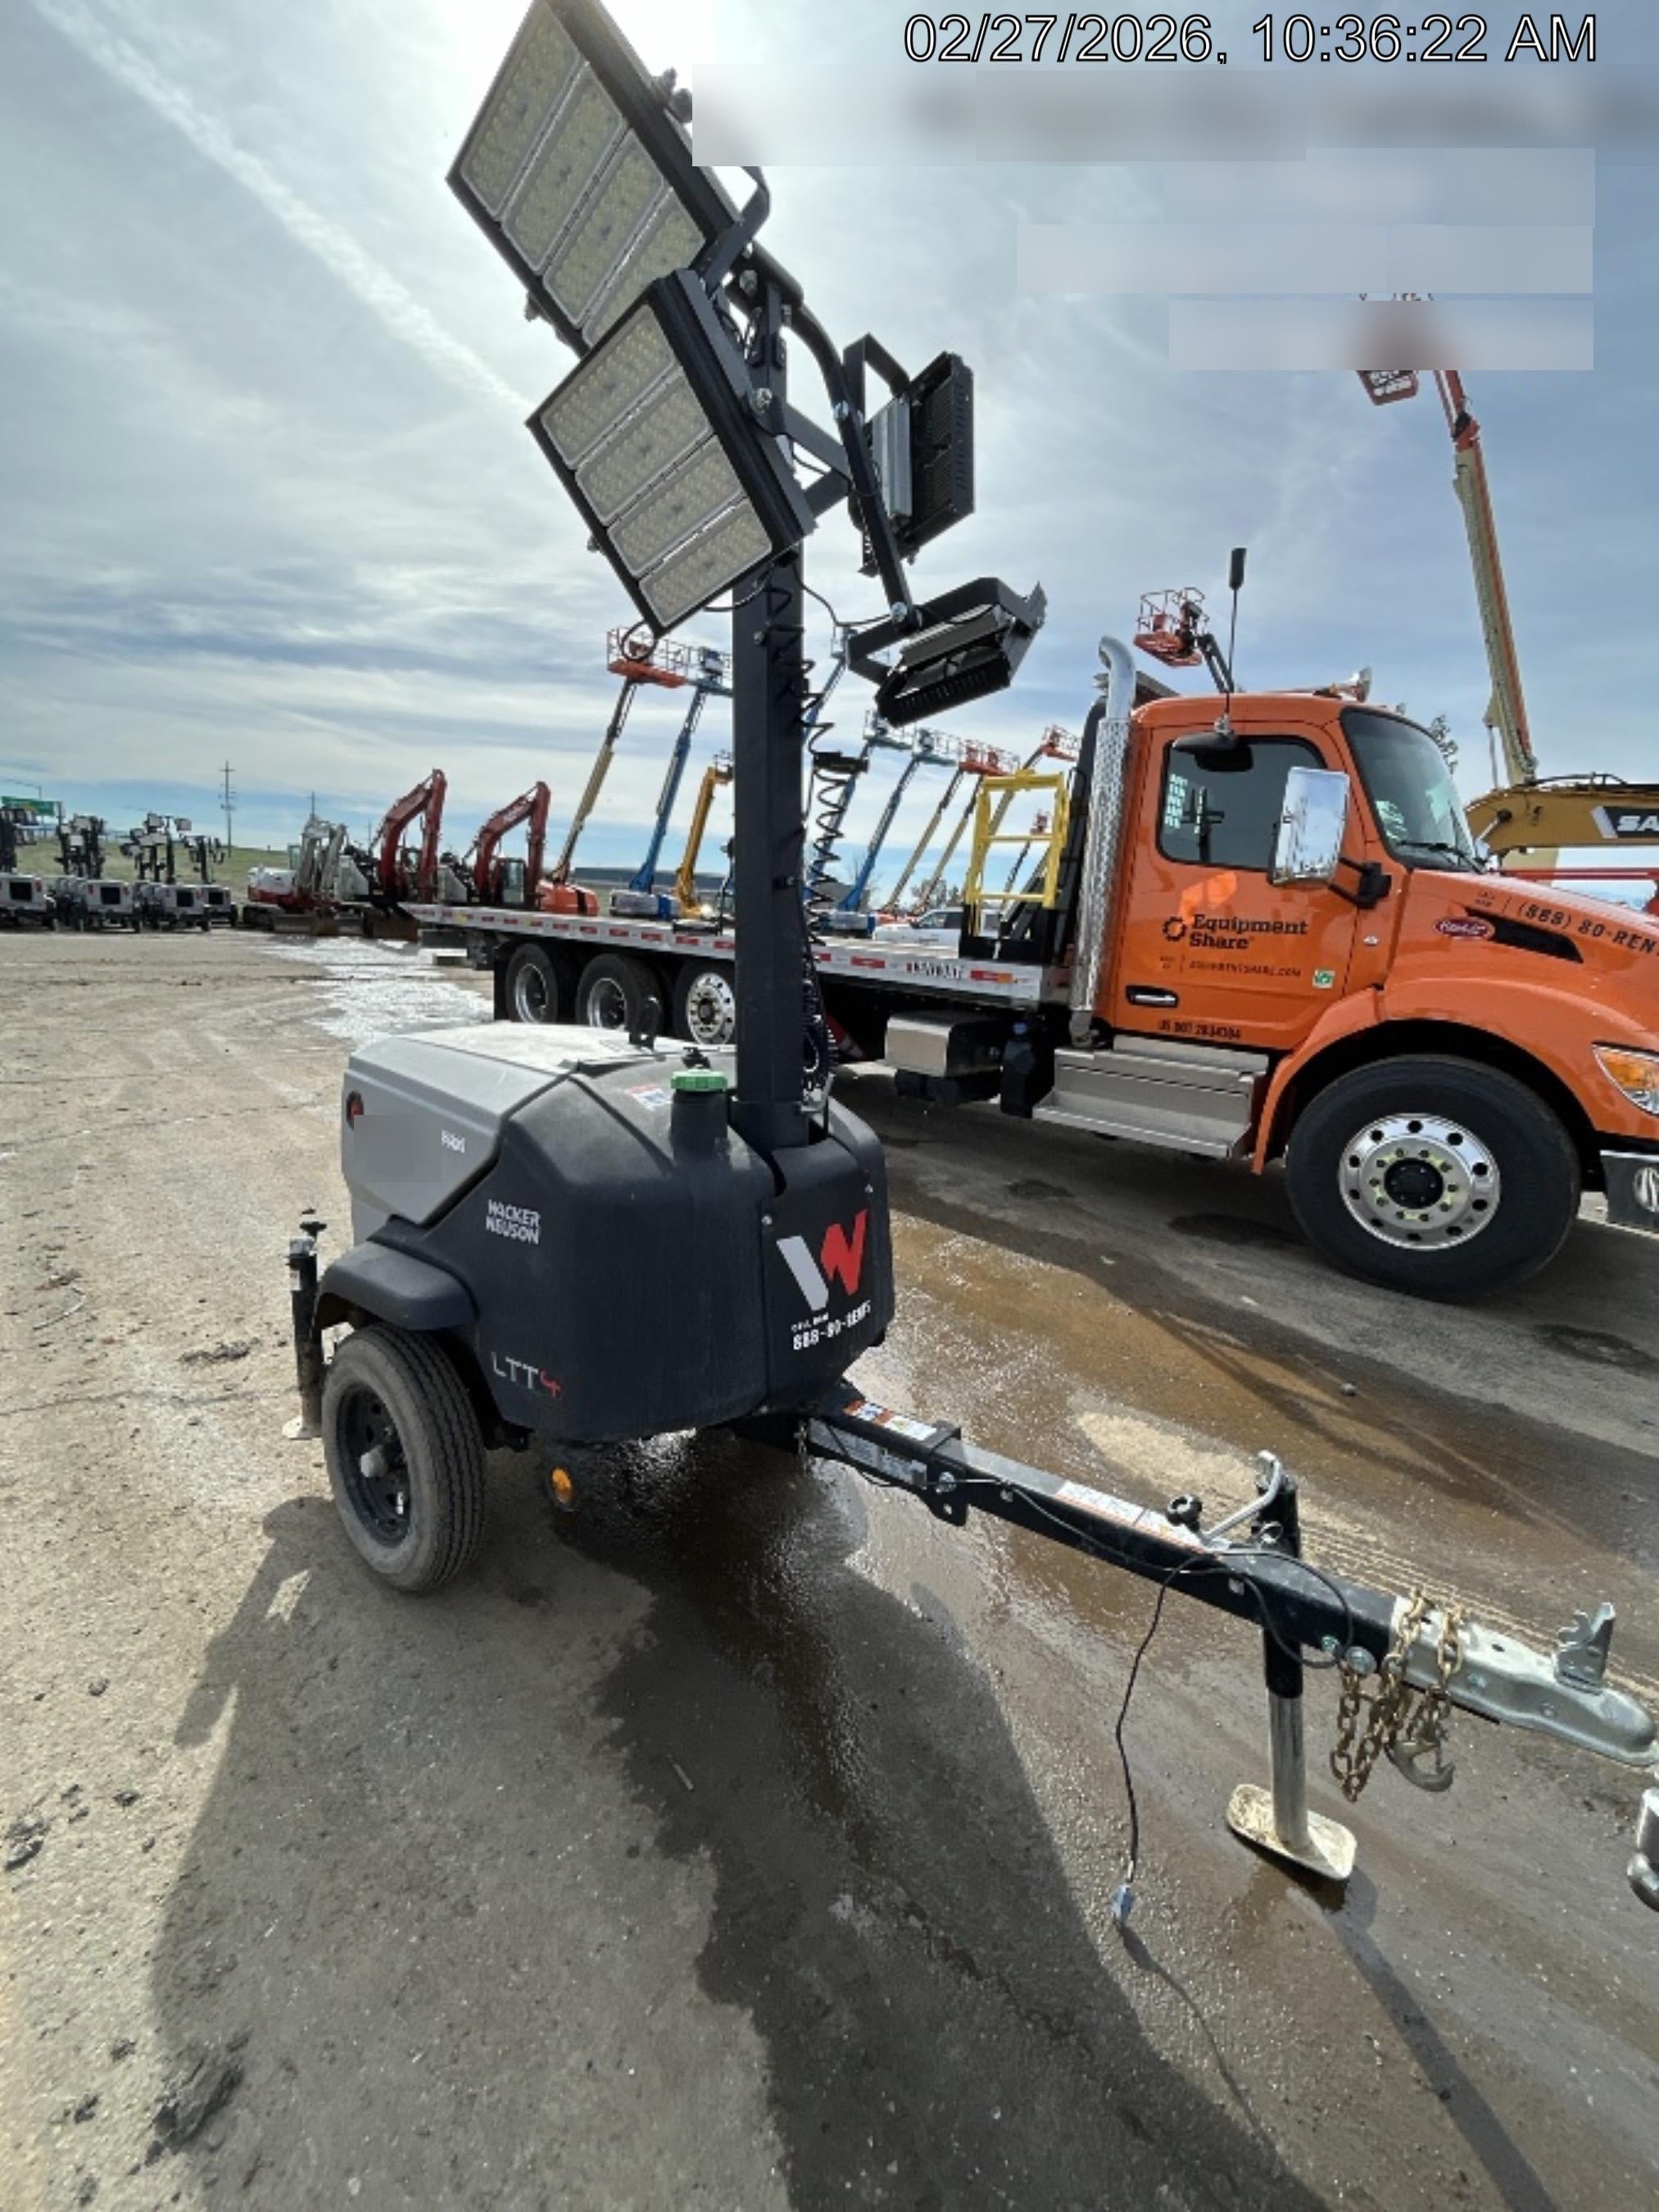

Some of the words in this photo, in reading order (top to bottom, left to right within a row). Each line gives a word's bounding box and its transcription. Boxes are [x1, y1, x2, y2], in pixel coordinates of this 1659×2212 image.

[1192, 913, 1308, 936] Equipment
[1518, 901, 1572, 929] (888)
[1578, 918, 1659, 957] 80-REN
[1189, 931, 1249, 950] Share
[487, 1199, 541, 1228] WACKER
[486, 1216, 540, 1244] NEUSON
[492, 1352, 562, 1398] LTT4
